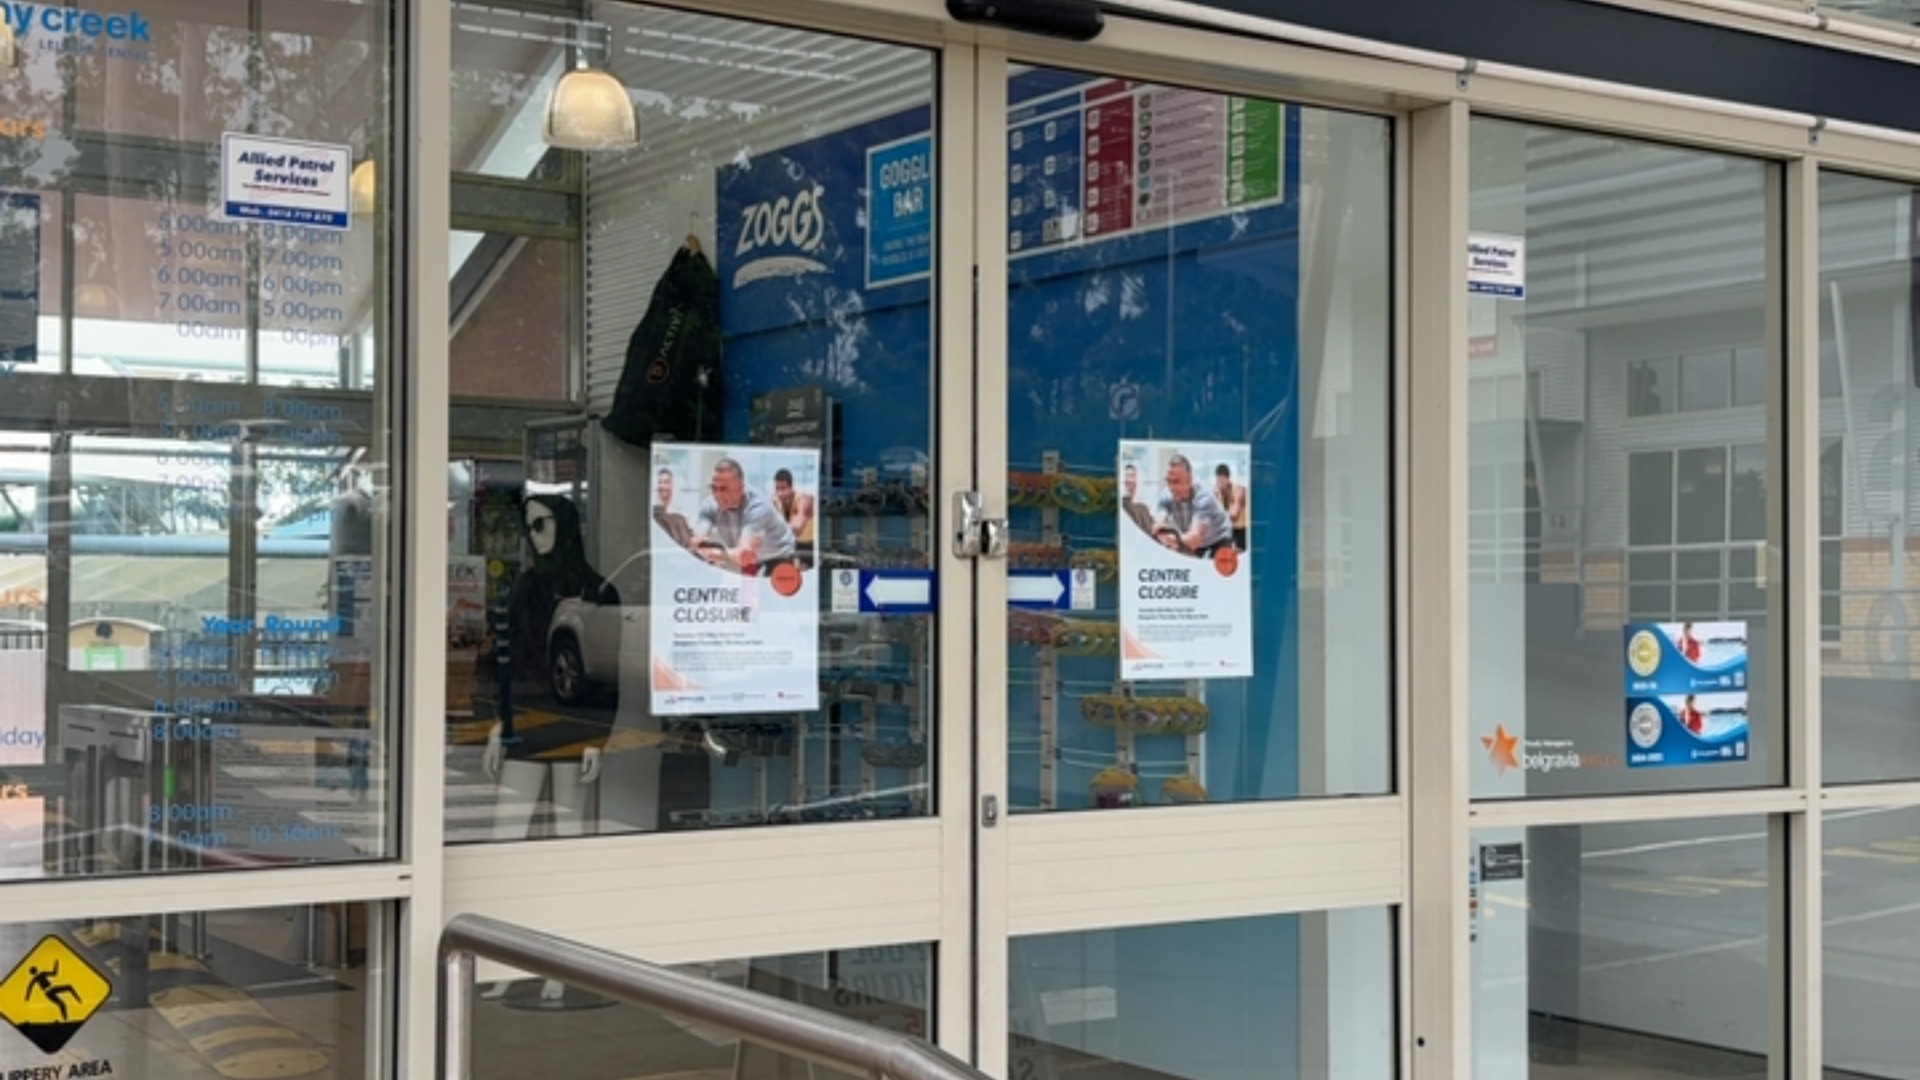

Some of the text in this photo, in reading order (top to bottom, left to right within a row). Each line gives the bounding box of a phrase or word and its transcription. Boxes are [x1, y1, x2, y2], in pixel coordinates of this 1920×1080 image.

[41, 7, 151, 41] creek
[238, 152, 335, 172] Allied Patrol
[880, 153, 929, 190] GOGGL
[254, 168, 318, 187] Services
[893, 187, 924, 218] BAR
[735, 185, 825, 257] ZOGGS
[158, 265, 342, 297] 6.00am 6.00pm
[159, 292, 342, 323] 7.00am 5.00pm
[1137, 568, 1191, 583] CENTRE
[673, 587, 740, 604] CENTRE
[1137, 585, 1199, 599] CLOSURE
[202, 614, 344, 635] Year Round
[673, 606, 752, 623] CLOSURE
[68, 1059, 112, 1079] AREA
